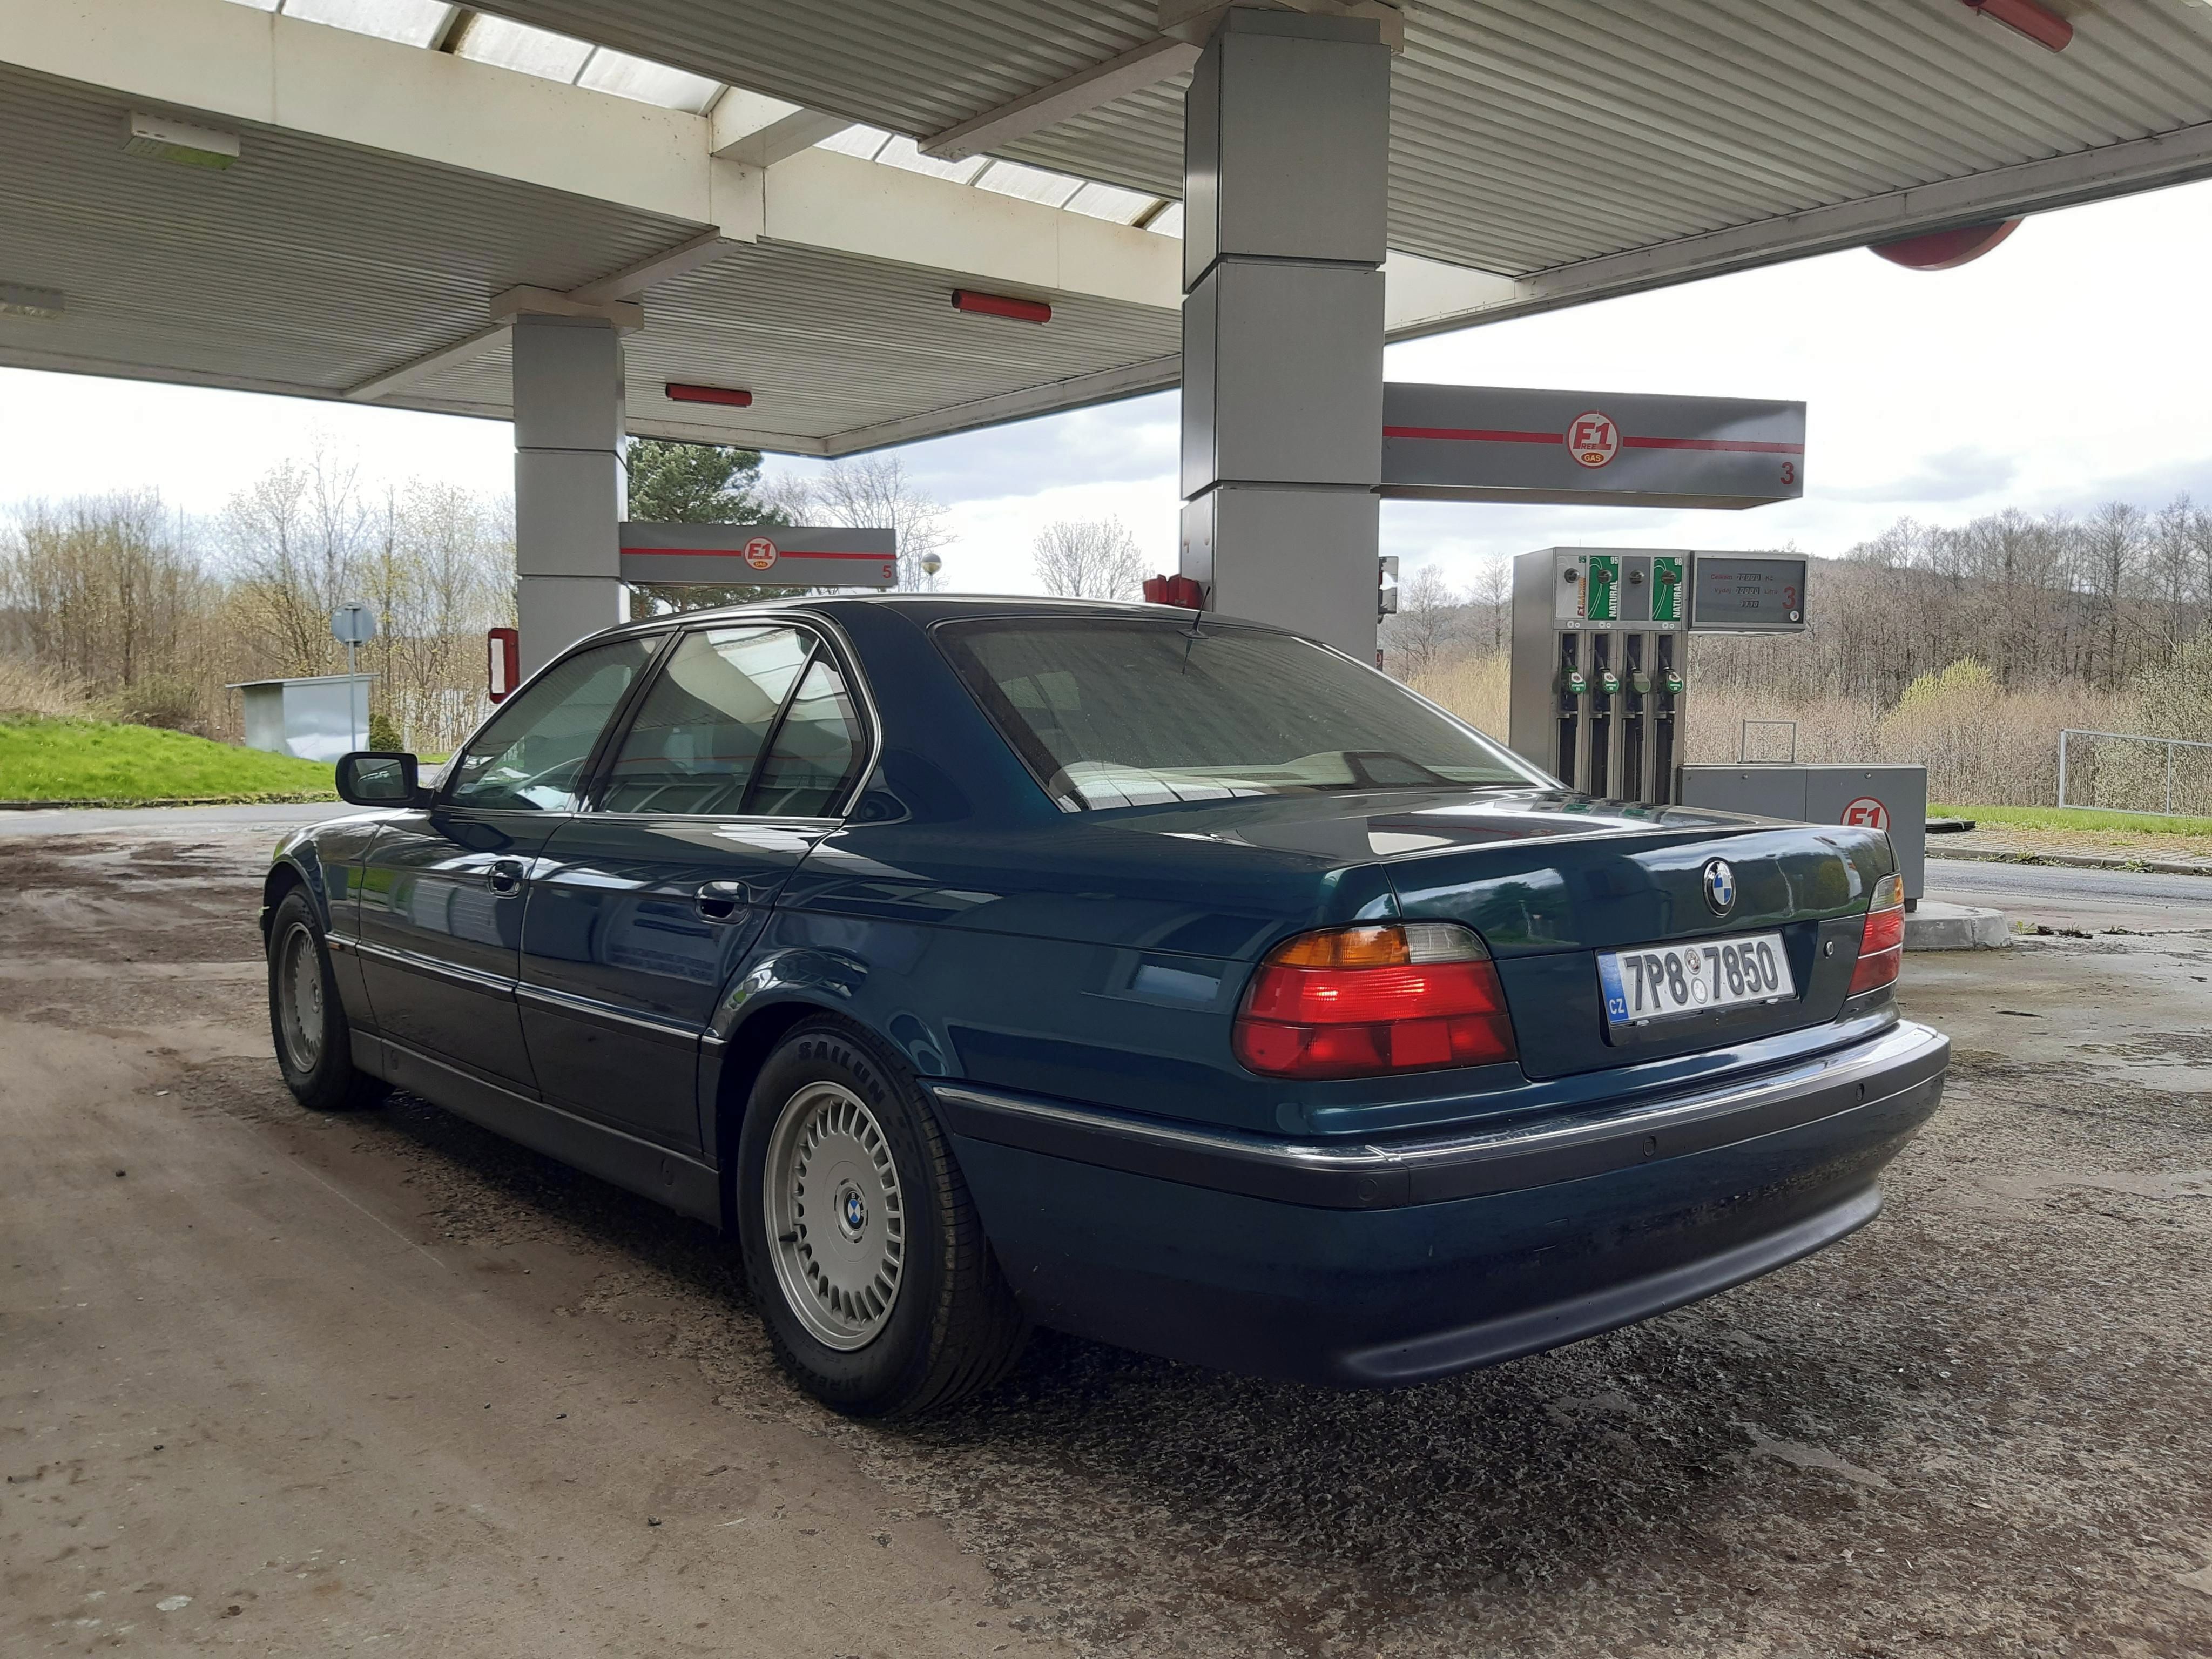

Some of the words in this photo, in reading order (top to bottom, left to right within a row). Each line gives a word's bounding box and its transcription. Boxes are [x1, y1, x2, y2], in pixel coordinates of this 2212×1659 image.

[1573, 422, 1612, 450] F1
[1781, 462, 1794, 485] 3
[747, 543, 773, 559] F1
[1610, 556, 1619, 565] 95
[1674, 558, 1682, 566] 98
[883, 565, 892, 579] 5
[1608, 580, 1618, 618] NATURAL
[1672, 581, 1683, 619] NATURAL
[1782, 586, 1796, 609] 3
[1848, 807, 1882, 829] F1
[1623, 952, 1688, 1011] 7P8
[1702, 941, 1779, 999] 7850
[1609, 997, 1625, 1015] CZ
[798, 1041, 886, 1105] SAILUN
